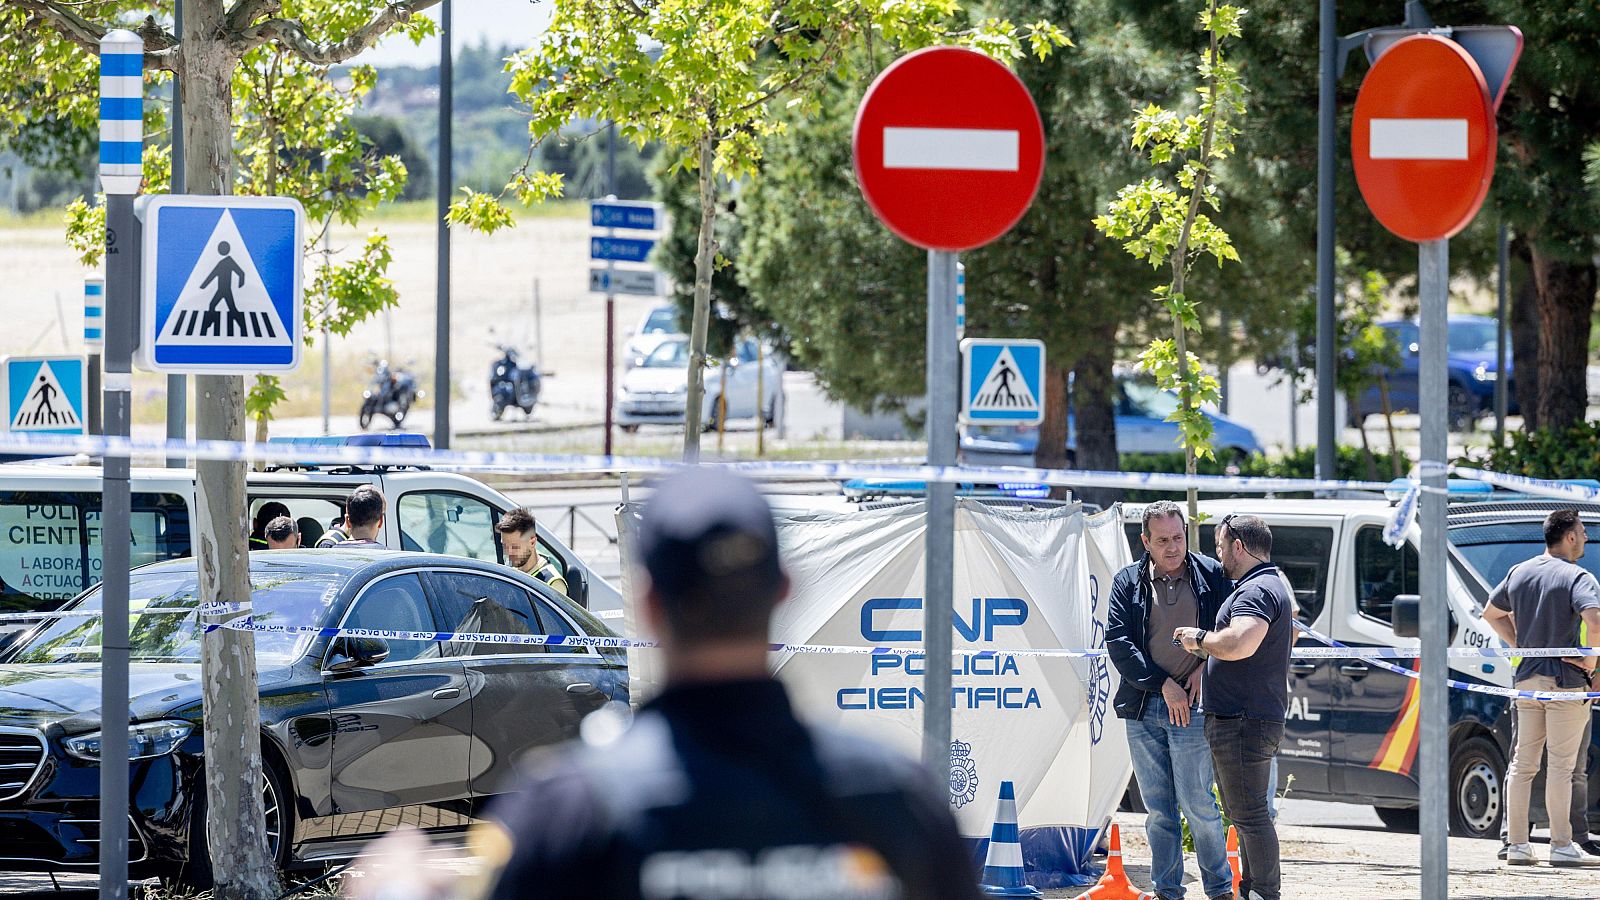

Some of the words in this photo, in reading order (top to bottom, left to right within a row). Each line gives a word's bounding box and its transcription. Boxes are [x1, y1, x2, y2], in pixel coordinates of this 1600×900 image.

[861, 598, 1029, 642] CNP
[459, 634, 491, 642] PASAR
[493, 634, 508, 642] NO
[568, 637, 601, 647] PASAR
[603, 638, 618, 647] NO
[1469, 631, 1492, 648] 091
